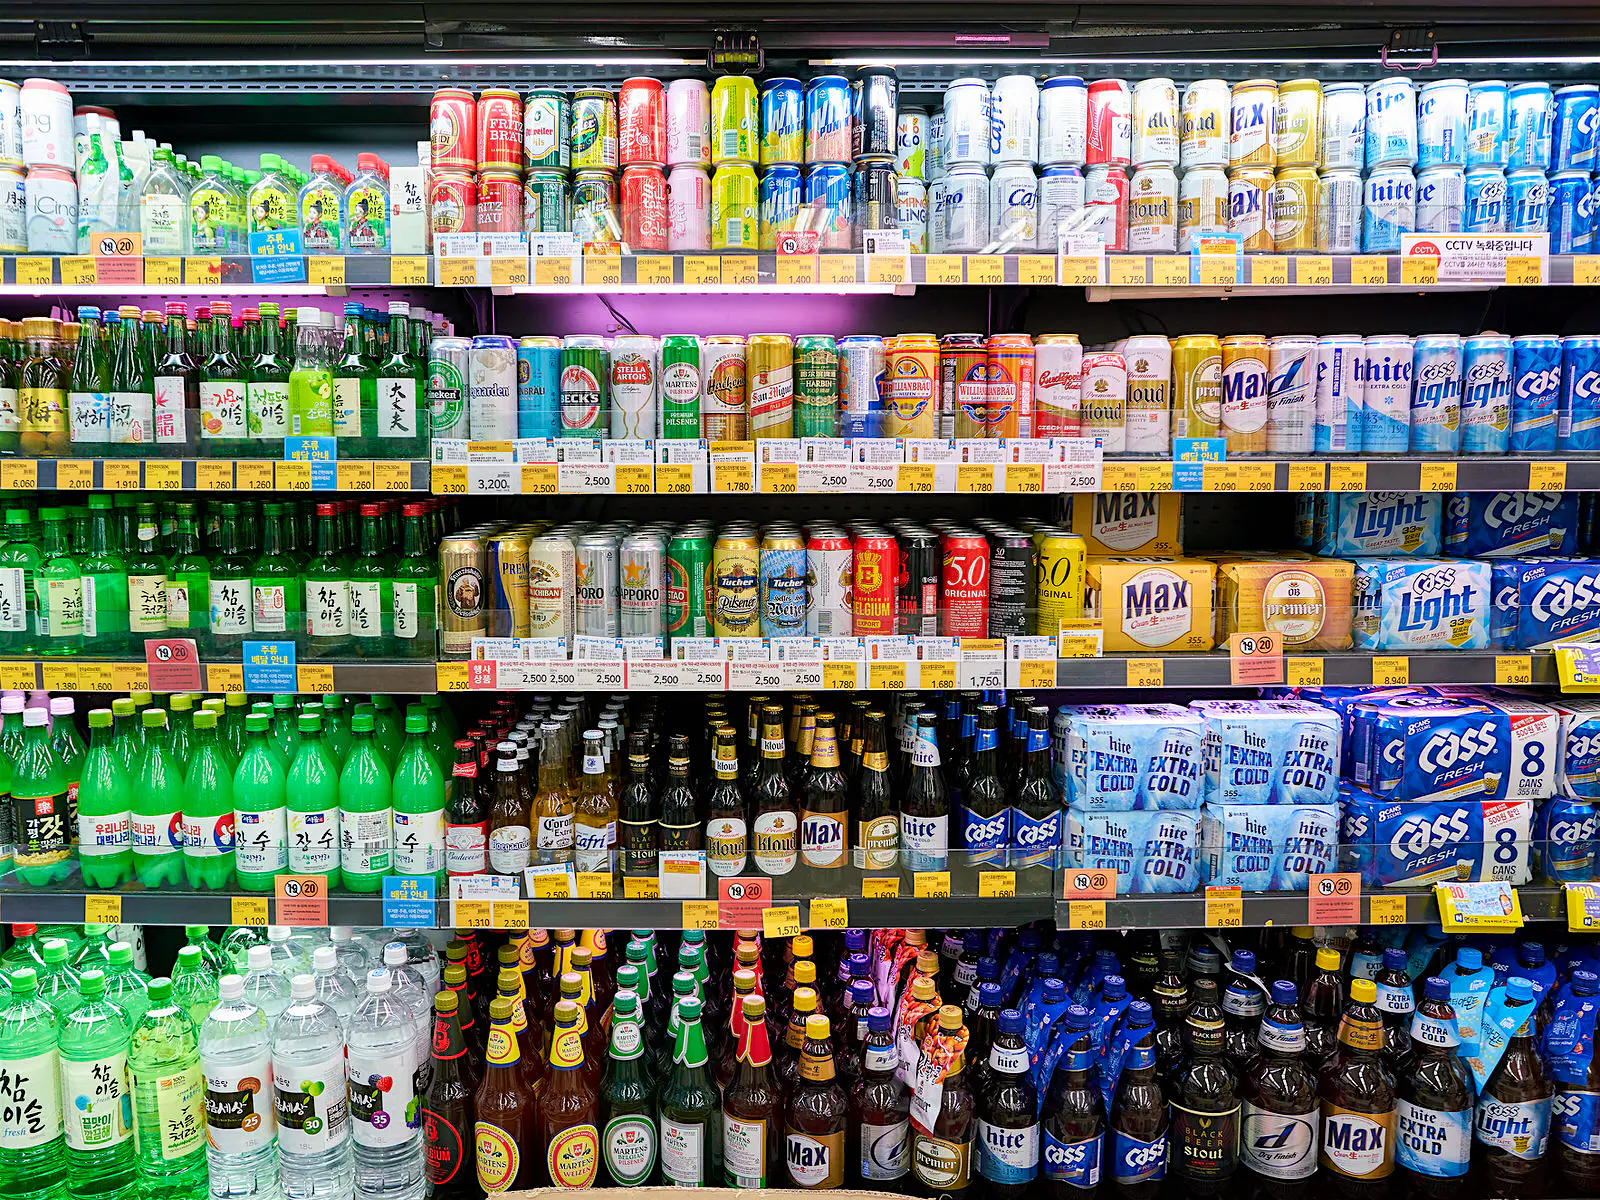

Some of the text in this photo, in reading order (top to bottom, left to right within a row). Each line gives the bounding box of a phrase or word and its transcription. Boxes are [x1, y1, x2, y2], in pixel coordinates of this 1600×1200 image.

[1446, 240, 1474, 250] CCTV
[616, 366, 647, 375] STELLA
[1365, 357, 1411, 382] hite
[616, 372, 647, 382] ARTOIS
[666, 380, 698, 388] MARTENS
[806, 380, 832, 388] HARBIN
[1222, 371, 1268, 404] Max
[666, 418, 698, 426] PILSENER
[1502, 514, 1551, 538] FRESH
[721, 577, 754, 587] Tucher
[945, 588, 987, 599] ORIGINAL
[1126, 579, 1190, 620] Max
[1266, 600, 1323, 620] premier
[1398, 584, 1477, 633] Light
[1259, 639, 1271, 650] 20
[175, 647, 186, 658] 20
[1109, 736, 1132, 754] hite
[1164, 739, 1193, 757] hite
[1299, 734, 1329, 752] hite
[1091, 750, 1138, 773] EXTRA
[1282, 750, 1333, 776] EXTRA
[1520, 740, 1546, 778] 8
[1148, 755, 1198, 779] EXTRA
[1434, 762, 1485, 786] FRESH
[1096, 772, 1134, 793] COLD
[1147, 774, 1190, 797] COLD
[1282, 769, 1326, 791] COLD
[1518, 778, 1543, 788] CANS
[802, 822, 840, 841] Max
[902, 818, 936, 838] hite
[1494, 828, 1518, 864] 8
[1405, 848, 1457, 872] FRESH
[1492, 865, 1516, 875] CANS
[304, 882, 316, 894] 20
[748, 886, 760, 896] 20
[1338, 881, 1350, 892] 20
[1386, 992, 1411, 1005] EXTRA
[1388, 1001, 1410, 1012] COLD
[1420, 1022, 1448, 1037] EXTRA
[1422, 1032, 1446, 1044] COLD
[997, 1056, 1019, 1069] hite
[244, 1116, 258, 1127] 25
[374, 1114, 387, 1125] 35
[1410, 1107, 1438, 1125] hite
[1477, 1105, 1532, 1139] Light
[305, 1120, 320, 1130] 30
[1185, 1126, 1224, 1138] BLACK
[1399, 1116, 1447, 1142] EXTRA
[3, 1128, 27, 1138] fresh
[986, 1126, 1024, 1148] hite
[1326, 1119, 1384, 1152] Max
[1185, 1138, 1224, 1148] BEER
[1402, 1132, 1443, 1157] COLD
[614, 1145, 648, 1156] MARTENS
[787, 1140, 826, 1167] Max
[1184, 1146, 1223, 1160] stout
[1272, 1150, 1298, 1160] Finish
[559, 1156, 593, 1170] MARTENS
[916, 1152, 958, 1168] premier
[563, 1166, 591, 1178] WEIZEN
